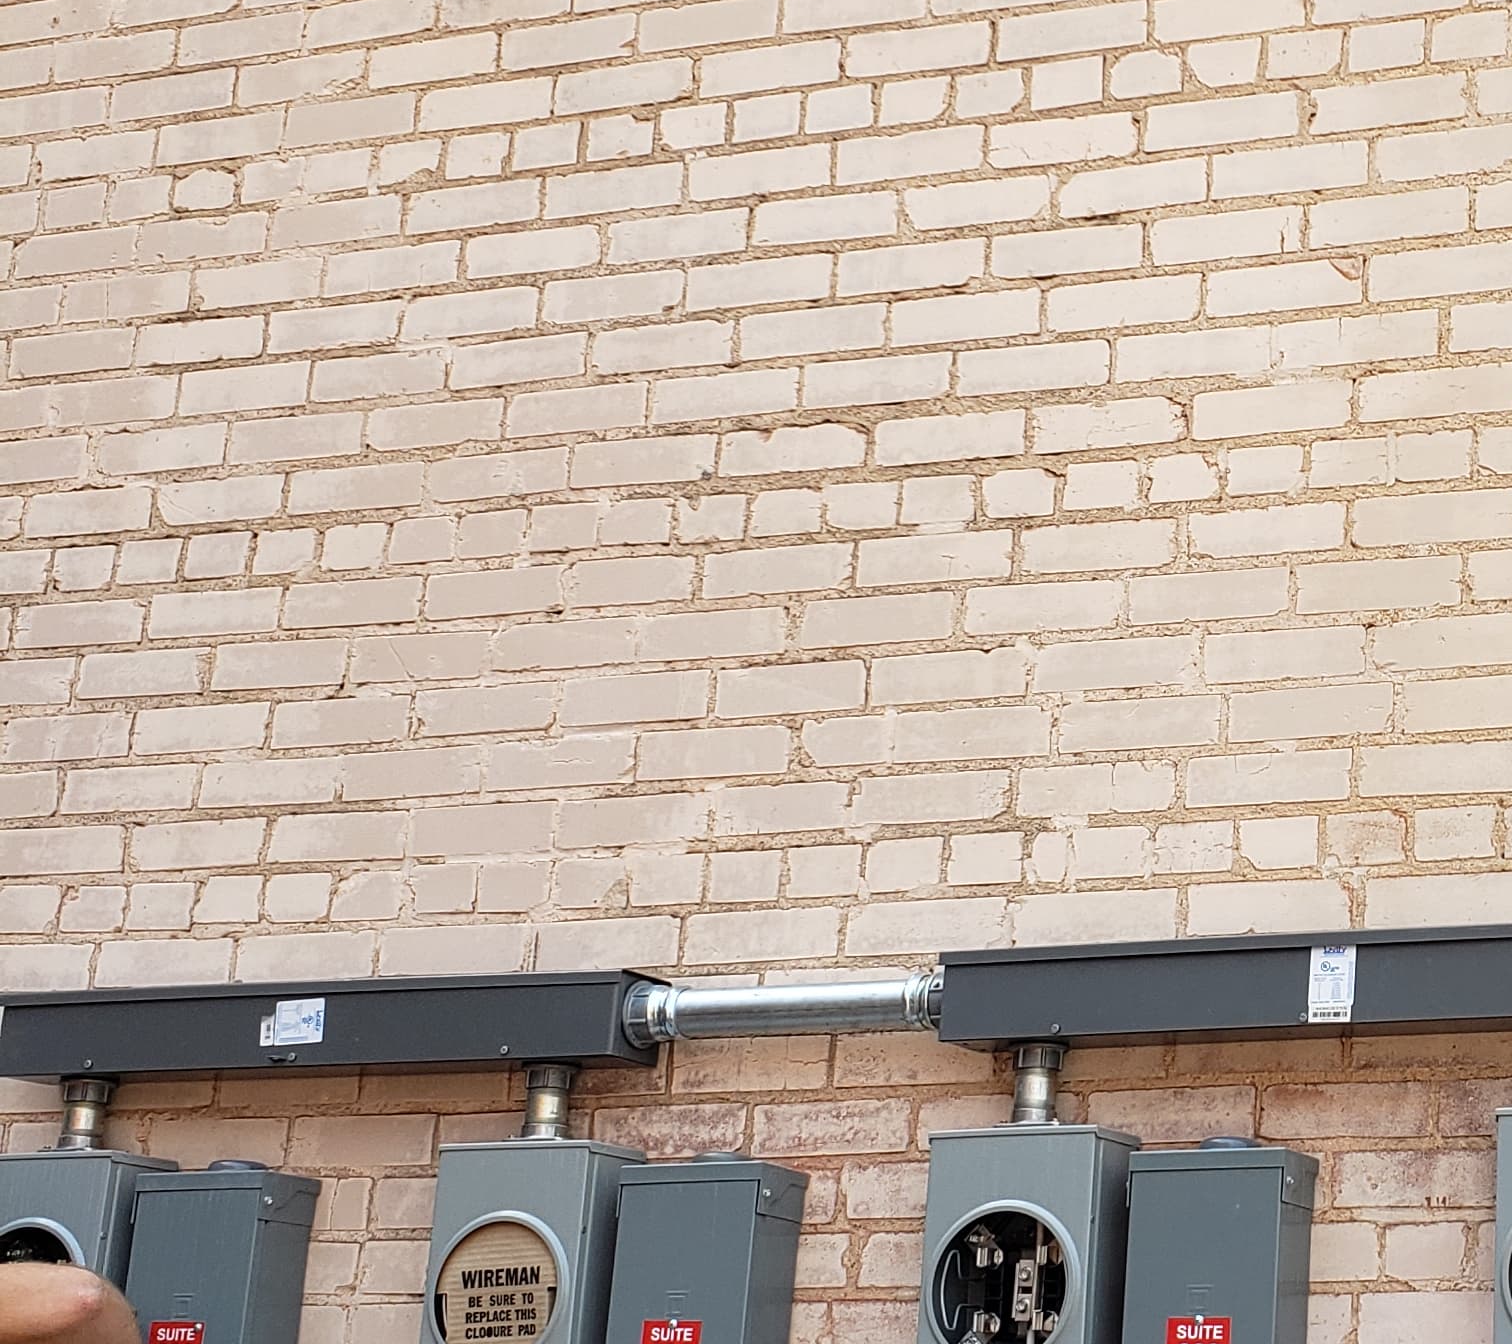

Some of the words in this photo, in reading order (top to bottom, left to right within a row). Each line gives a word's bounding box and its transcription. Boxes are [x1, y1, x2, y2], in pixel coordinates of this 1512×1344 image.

[461, 1265, 540, 1290] WIREMAN
[468, 1295, 483, 1308] BE
[489, 1293, 516, 1306] SURE
[521, 1292, 534, 1304] TO
[465, 1309, 512, 1324] REPLACE
[514, 1308, 536, 1320] THIS
[156, 1327, 196, 1341] SUITE
[518, 1323, 536, 1337] PAD
[650, 1327, 693, 1342] SUITE
[1176, 1324, 1223, 1340] SUITE
